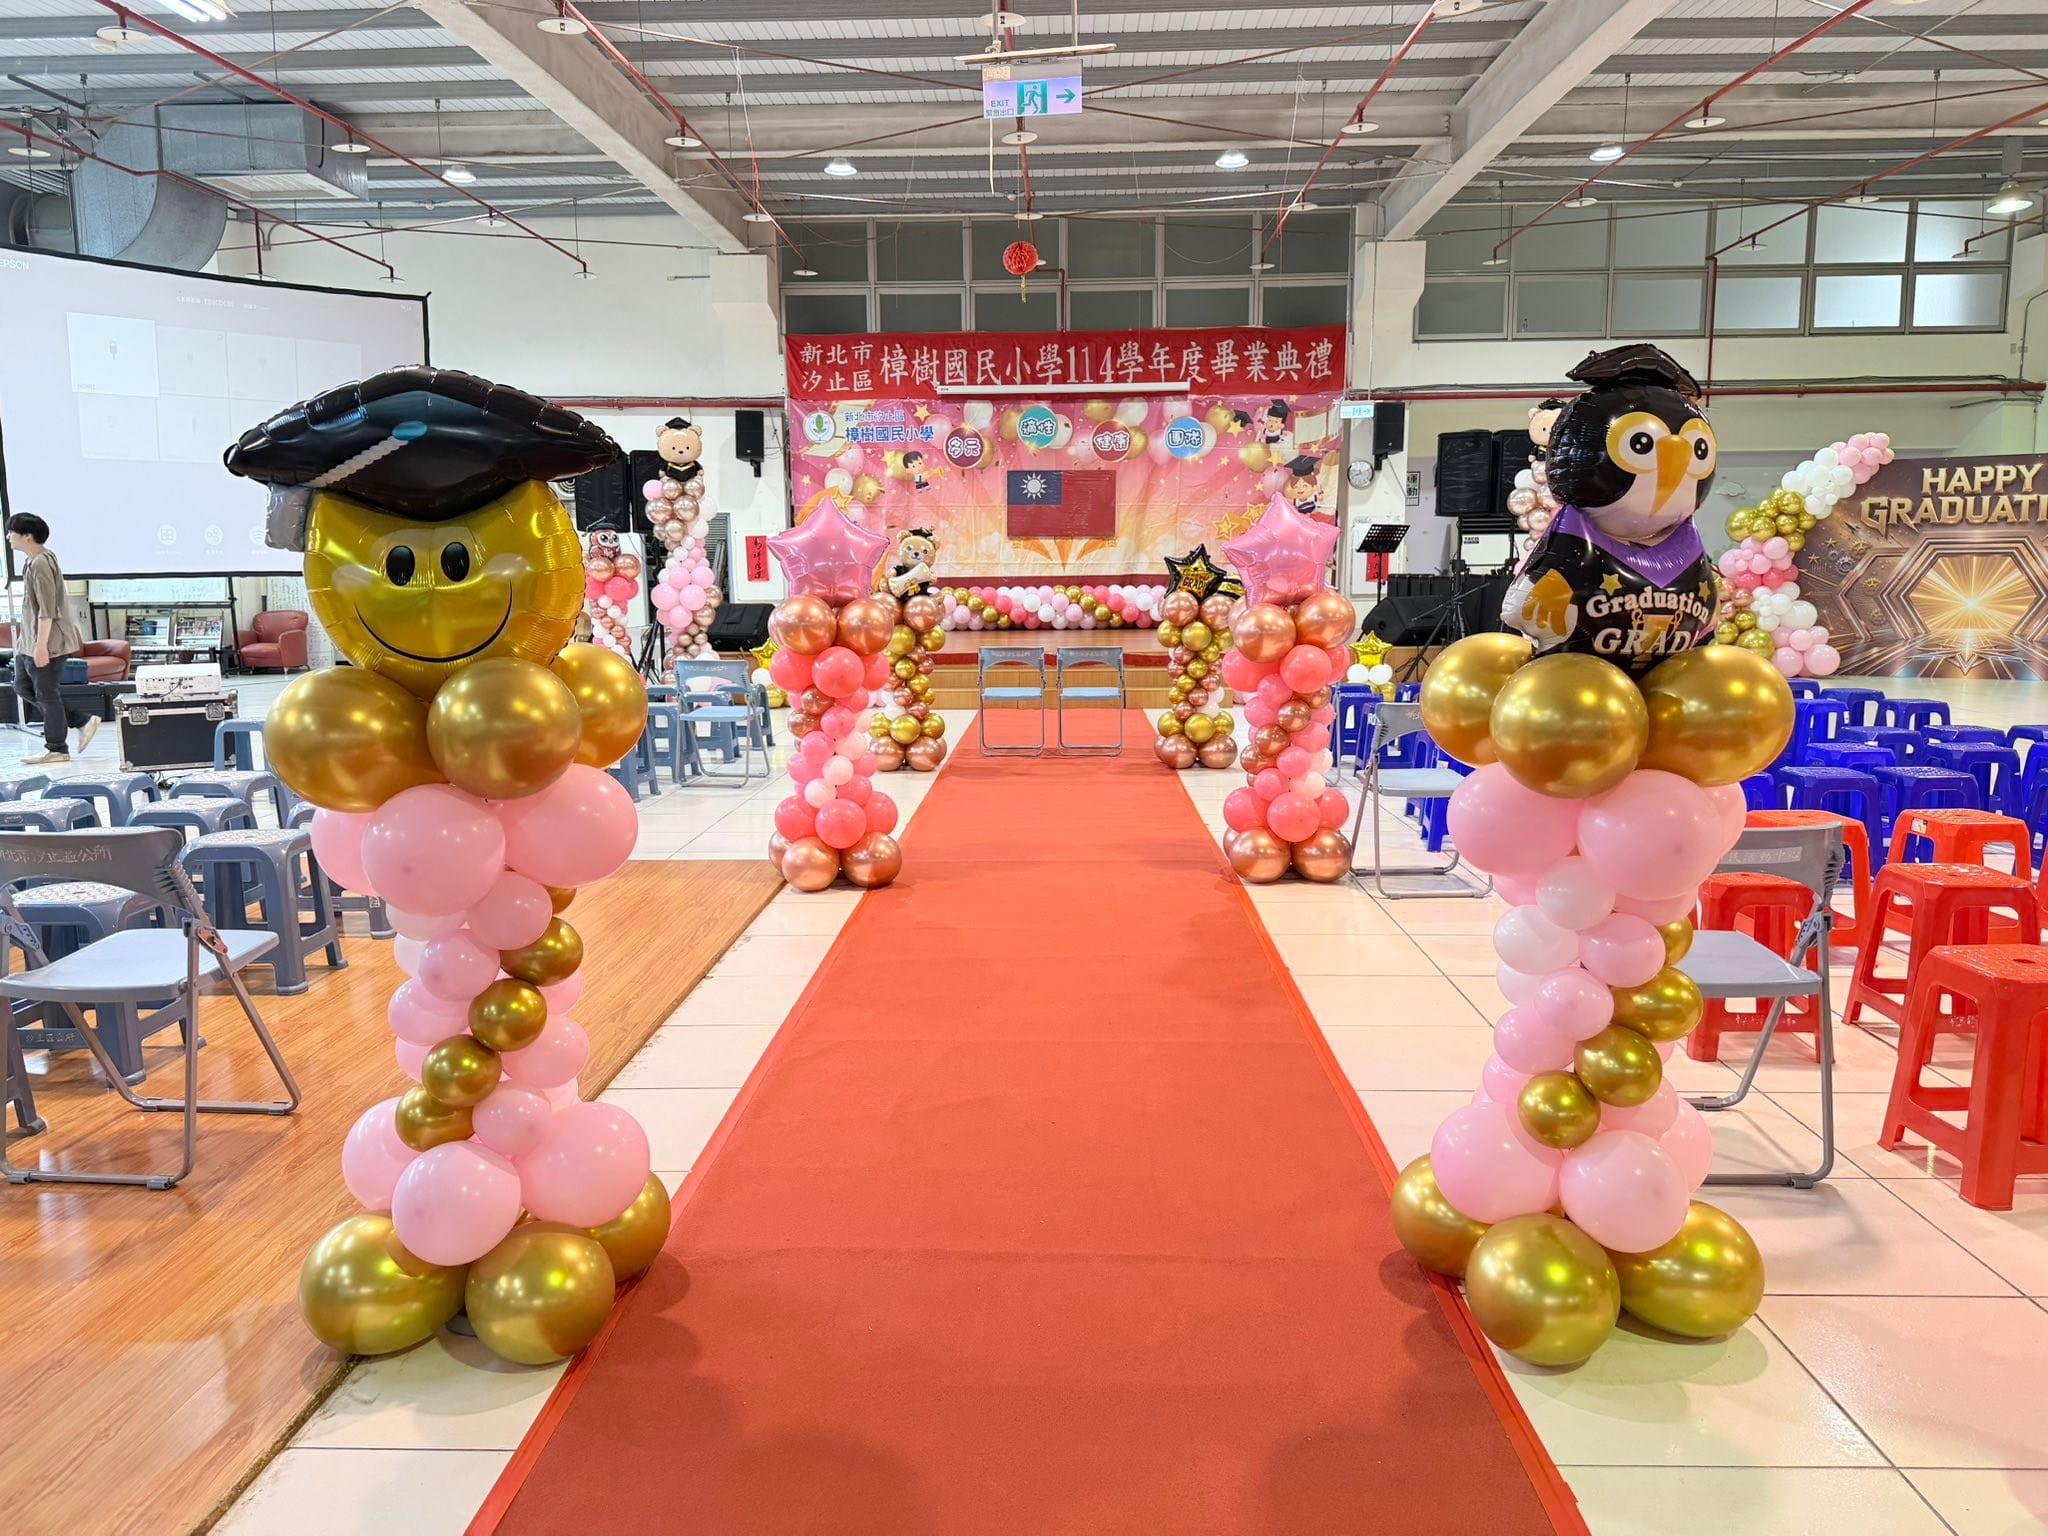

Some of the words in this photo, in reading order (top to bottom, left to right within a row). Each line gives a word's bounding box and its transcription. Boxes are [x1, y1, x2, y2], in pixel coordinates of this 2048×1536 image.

[800, 340, 874, 367] 新北市
[879, 338, 1334, 386] 樟樹國民小學114學年度畢業典禮
[802, 369, 874, 393] 汐止區
[844, 409, 905, 423] 新北市汐止區
[1020, 418, 1057, 436] 適性
[845, 425, 935, 443] 樟樹國民小學
[1093, 431, 1131, 451] 健康
[947, 436, 982, 458] 多元
[1921, 463, 2044, 496] HAPPY
[1585, 585, 1710, 624] Graduation
